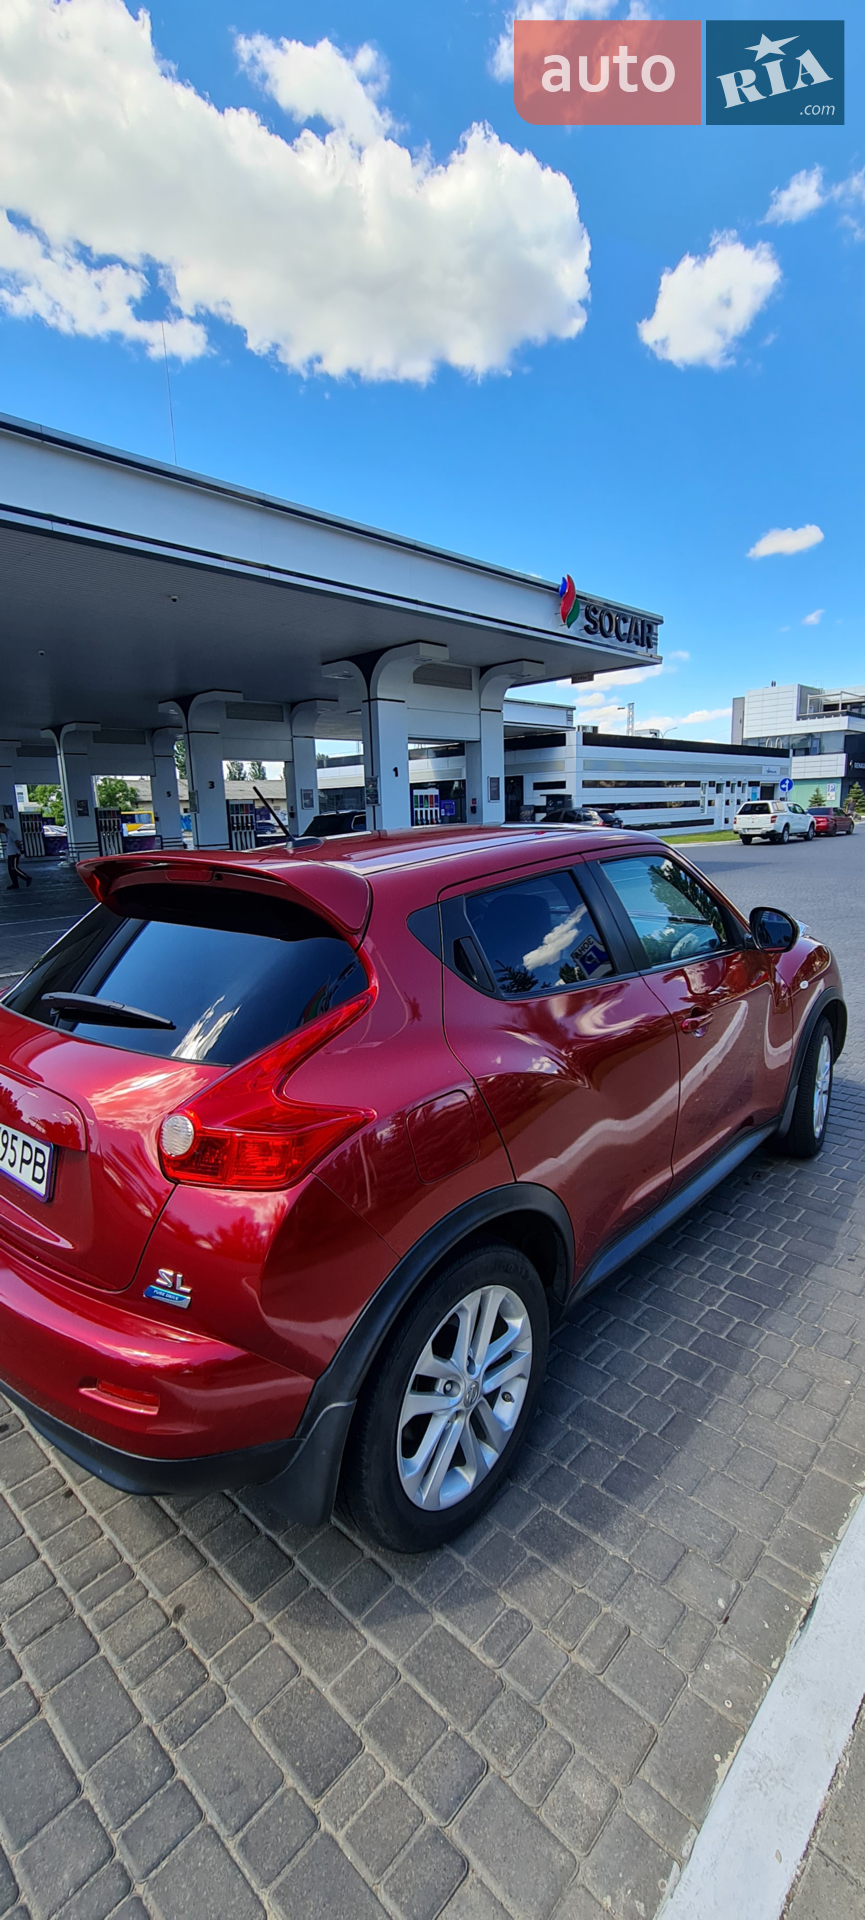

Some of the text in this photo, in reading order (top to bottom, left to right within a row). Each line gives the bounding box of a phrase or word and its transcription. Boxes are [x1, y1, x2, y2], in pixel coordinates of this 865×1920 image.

[583, 604, 654, 649] SOCAR
[392, 766, 399, 777] 1
[208, 780, 215, 789] 3
[0, 1127, 46, 1184] 95PB
[155, 1268, 192, 1293] SL
